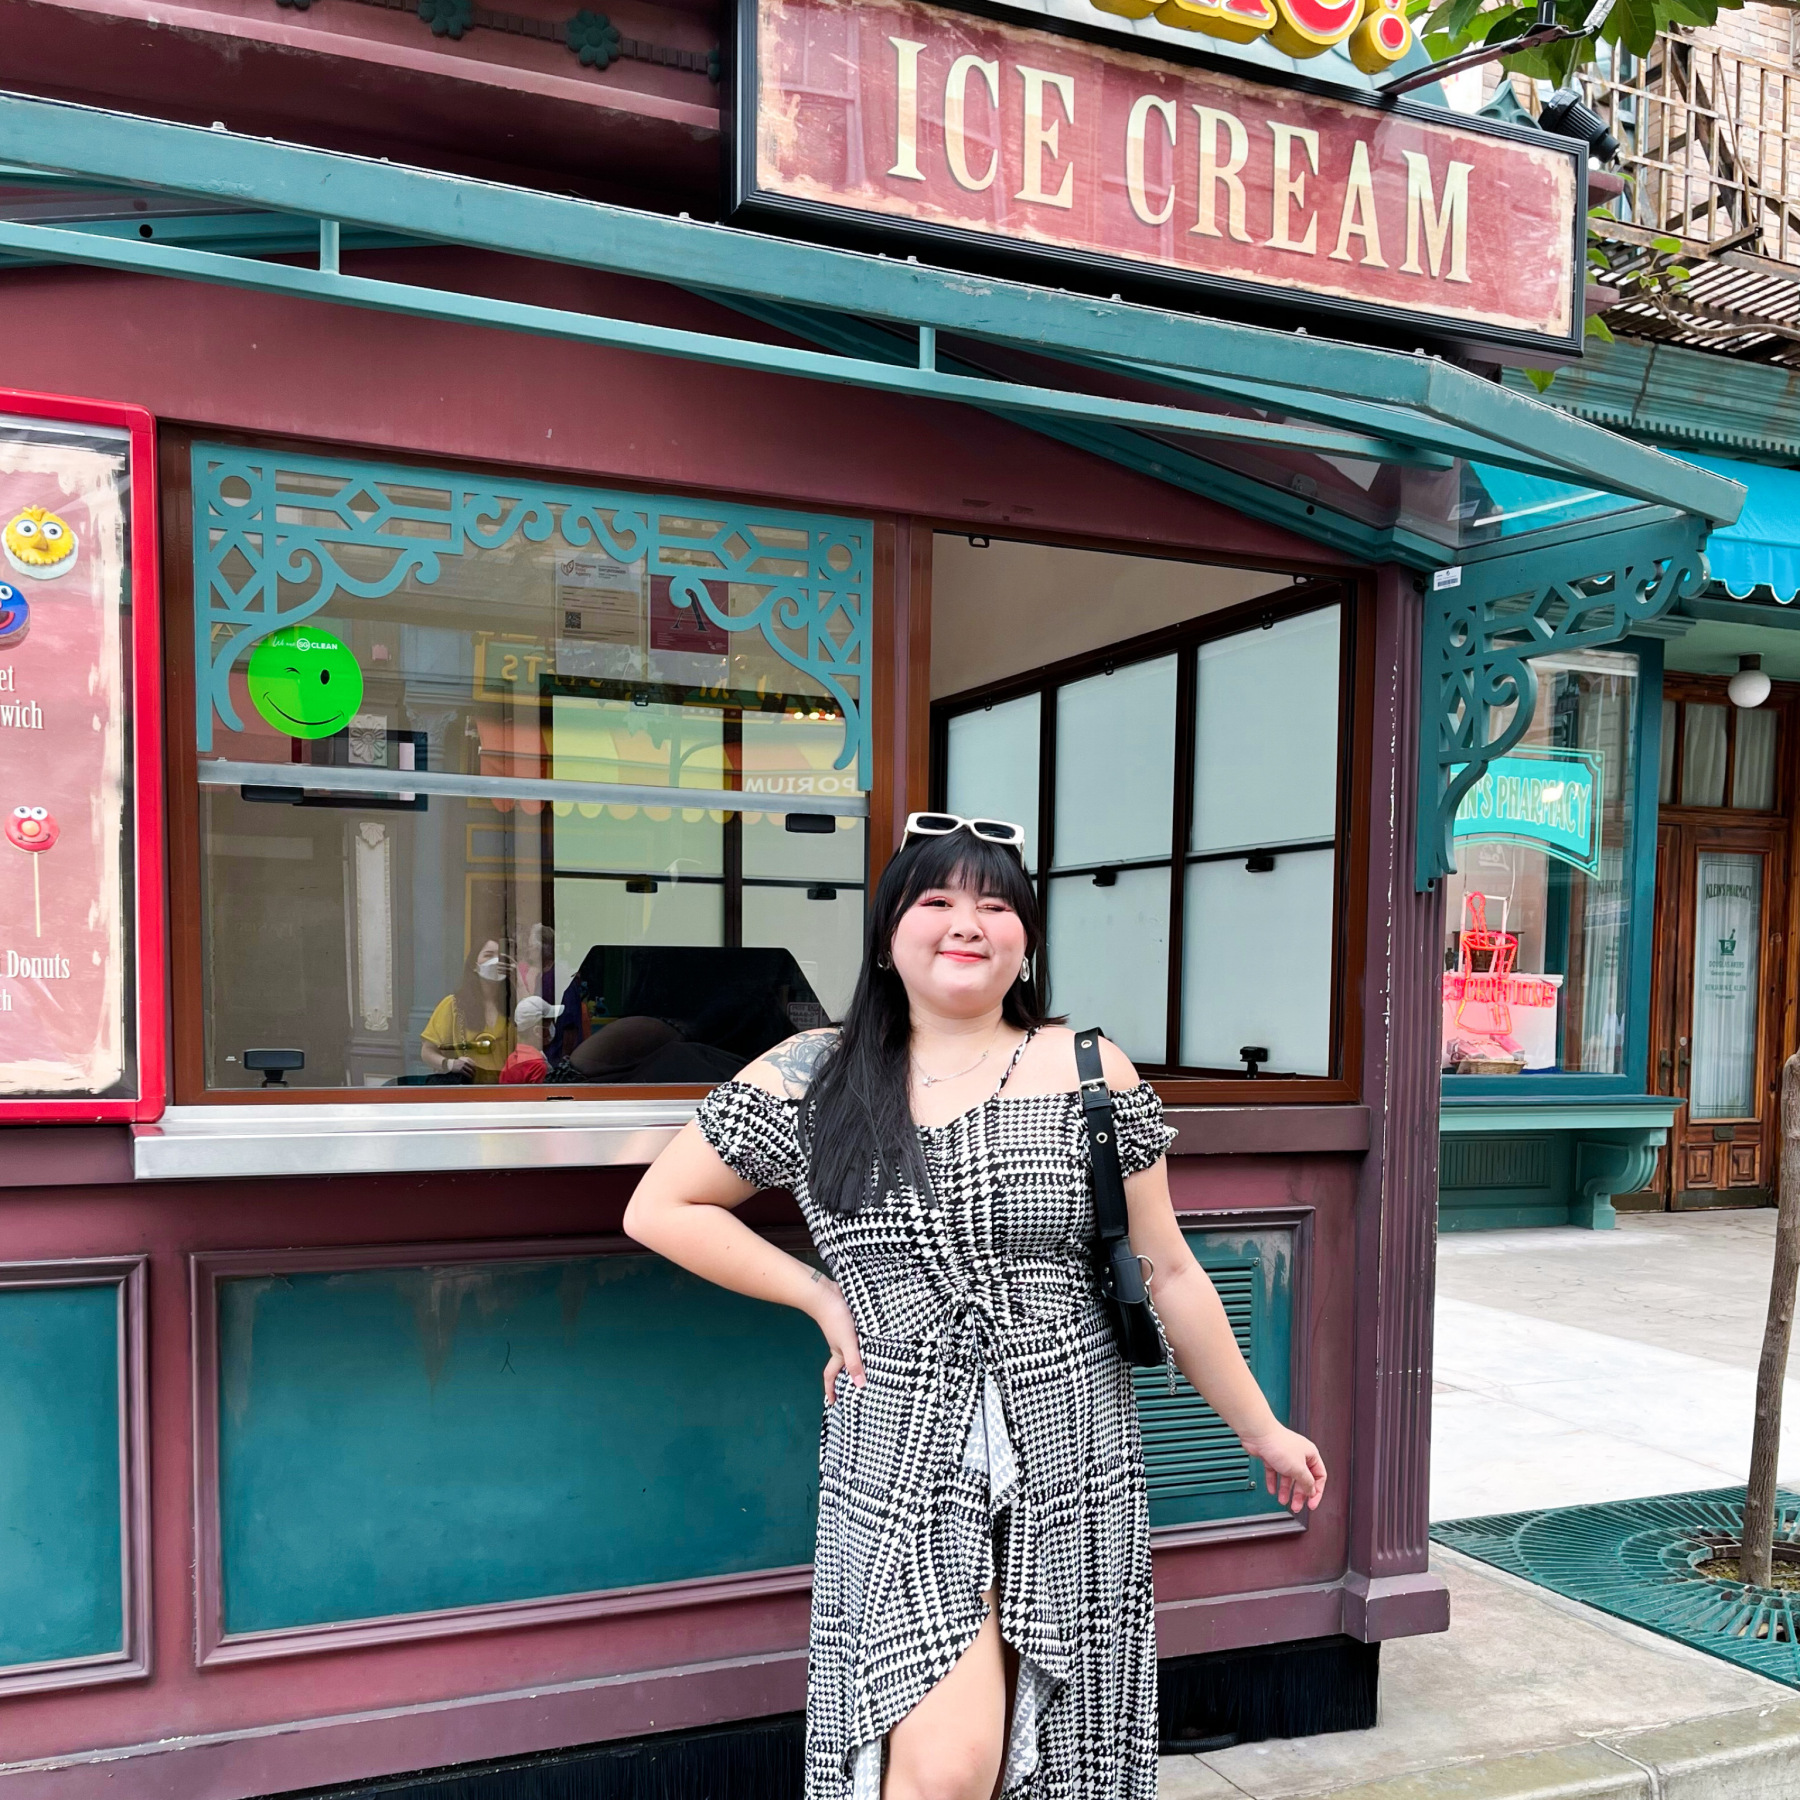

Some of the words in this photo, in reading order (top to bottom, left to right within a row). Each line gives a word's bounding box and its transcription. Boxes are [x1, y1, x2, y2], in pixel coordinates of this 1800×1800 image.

[886, 35, 1075, 210] ICE
[1125, 93, 1476, 284] CREAM
[311, 642, 338, 650] CLEAN
[1496, 776, 1591, 839] PHARMACY
[6, 949, 71, 979] Donuts
